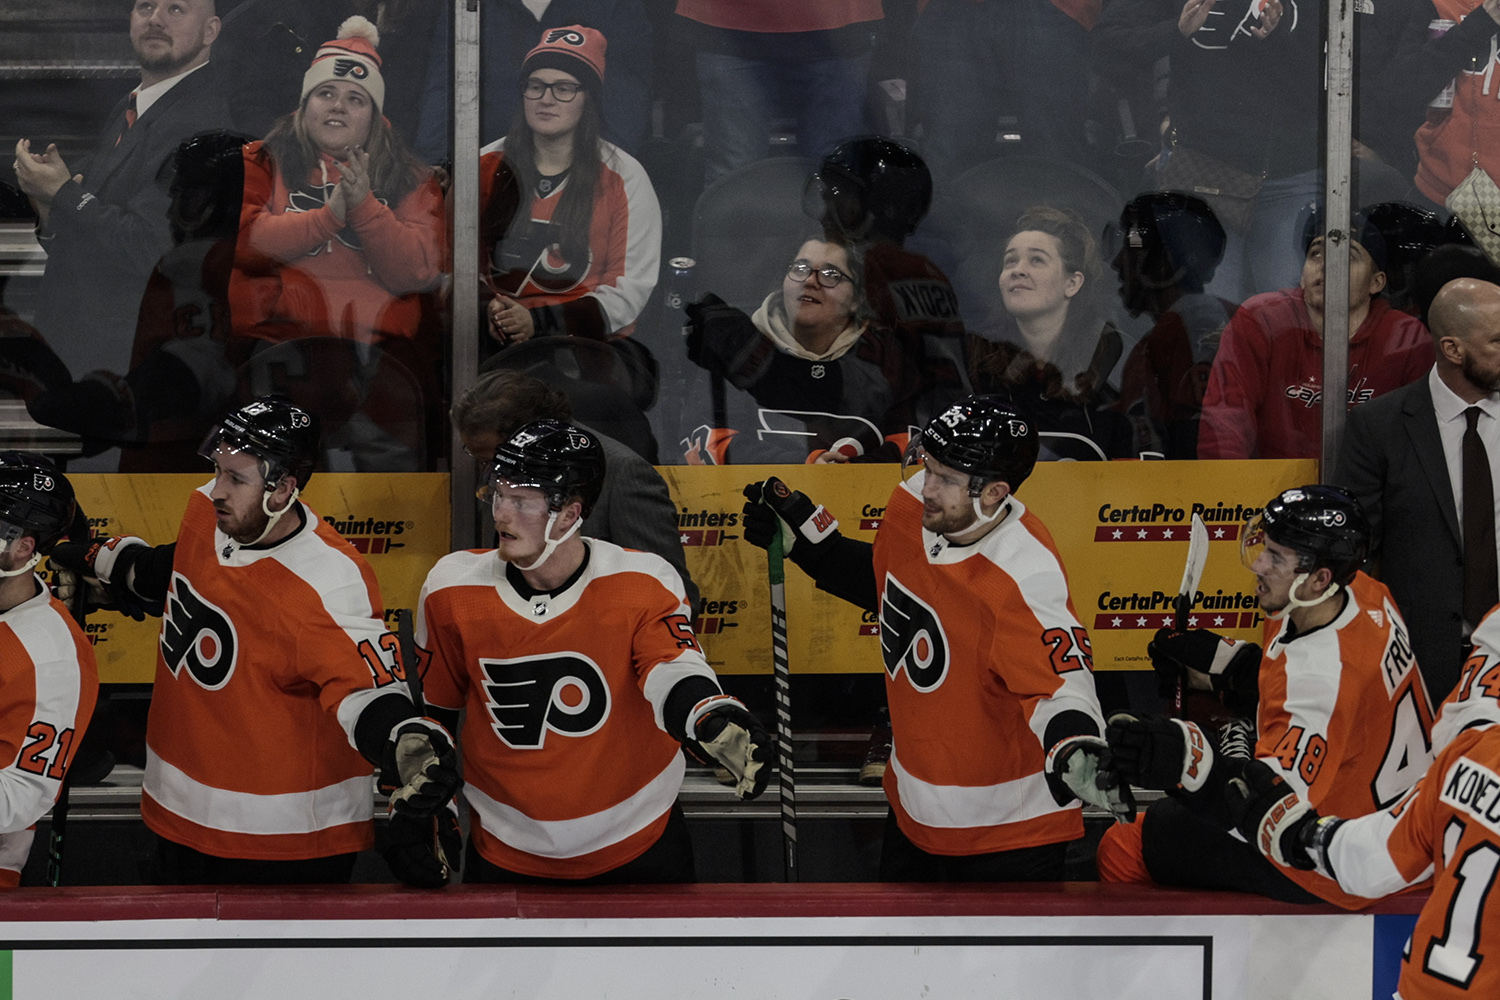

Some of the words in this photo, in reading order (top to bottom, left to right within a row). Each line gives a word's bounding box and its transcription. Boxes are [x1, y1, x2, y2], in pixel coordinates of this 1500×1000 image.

[940, 405, 967, 428] 25
[927, 427, 948, 447] CCM
[1098, 503, 1184, 523] CertaPro
[1041, 626, 1094, 675] 25
[16, 720, 75, 781] 21
[1273, 725, 1328, 786] 48
